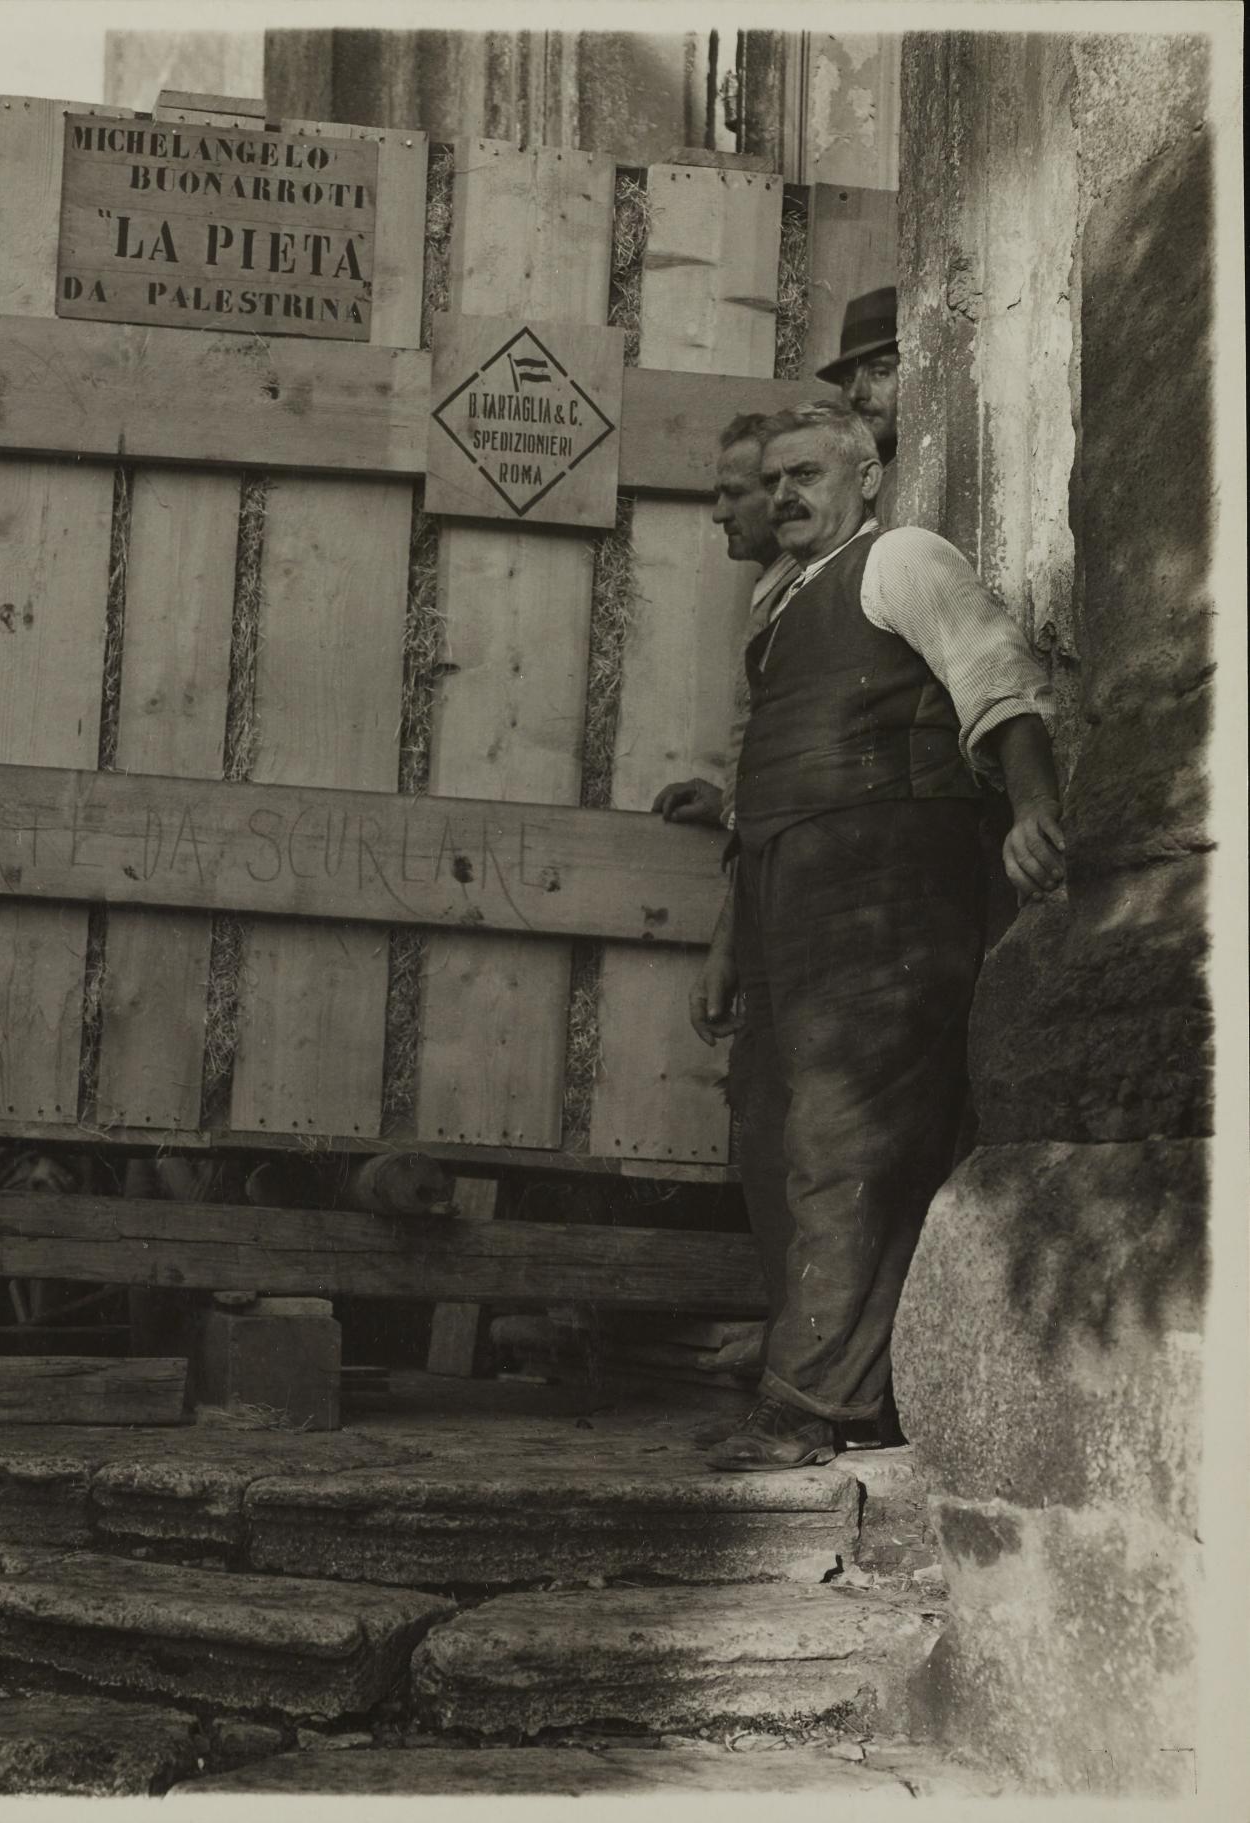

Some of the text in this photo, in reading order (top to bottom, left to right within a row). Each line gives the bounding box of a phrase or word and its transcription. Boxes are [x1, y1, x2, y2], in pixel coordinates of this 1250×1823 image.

[71, 126, 331, 171] MICHELANGELO
[129, 164, 366, 210] BUONARROTI
[63, 276, 363, 325] DA PALESTRINA
[482, 392, 551, 425] TARTAGLIA
[554, 404, 566, 425] &
[569, 400, 583, 427] C.
[472, 429, 573, 457] SPEDIZIONIERI
[499, 462, 543, 487] ROMA
[142, 800, 208, 884] DA
